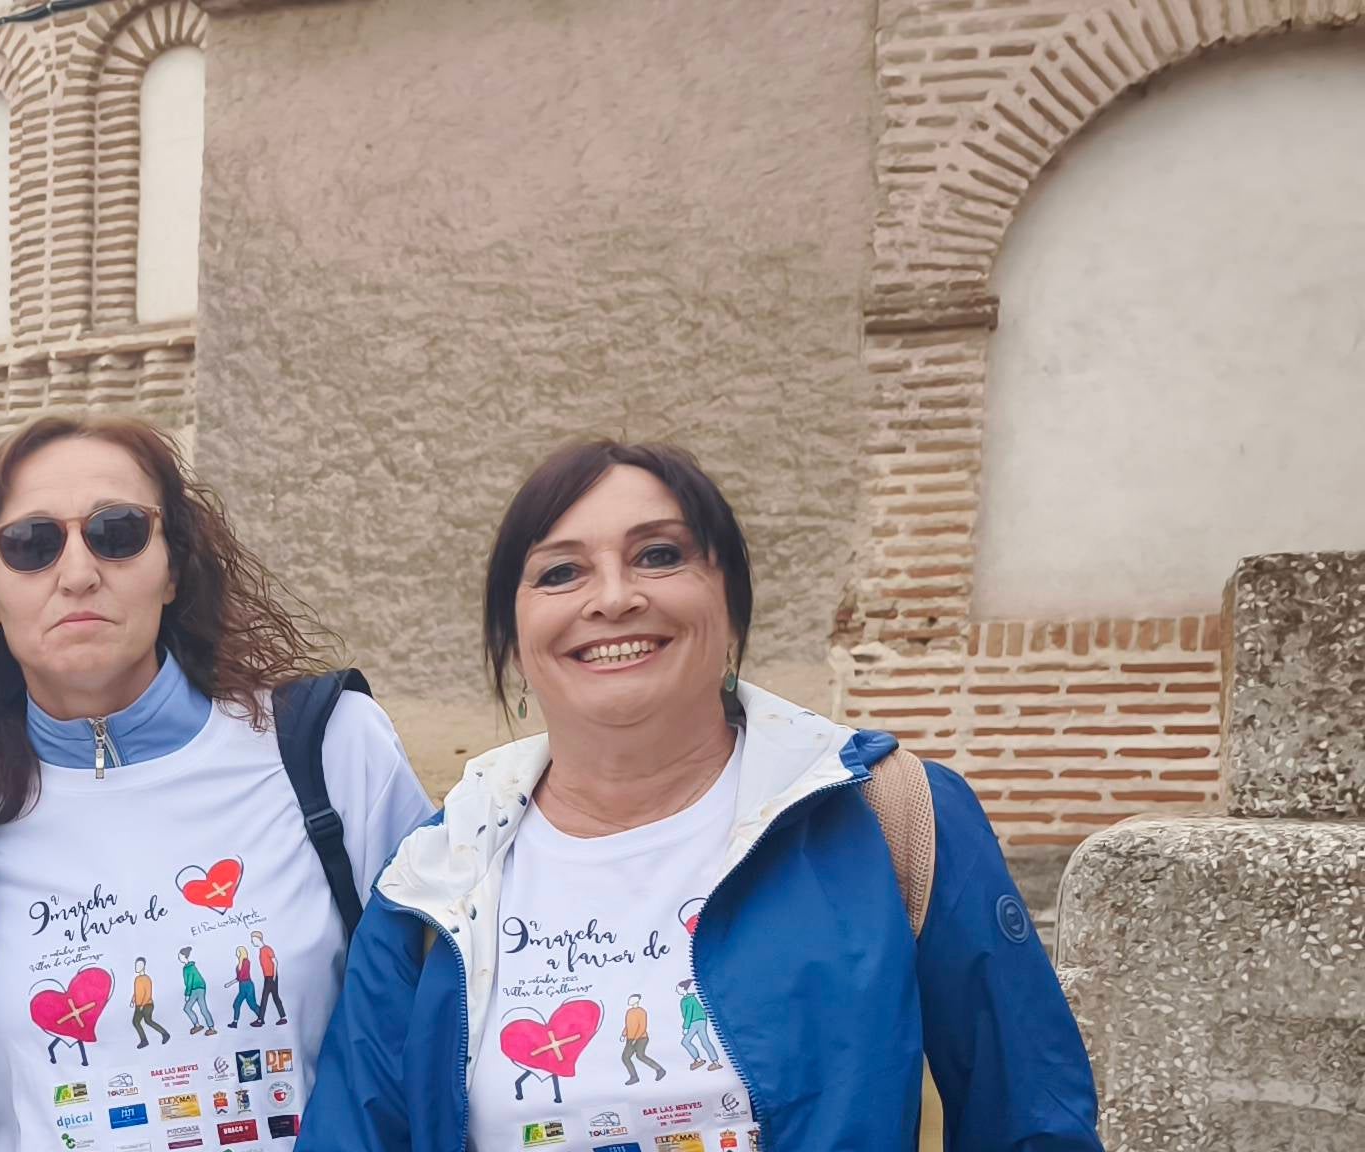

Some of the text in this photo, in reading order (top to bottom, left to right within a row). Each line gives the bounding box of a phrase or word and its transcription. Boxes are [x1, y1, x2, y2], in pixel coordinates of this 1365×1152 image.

[50, 883, 118, 921] marcha
[64, 894, 168, 942] a favor de
[529, 918, 618, 950] marcha
[547, 930, 671, 973] a favor de
